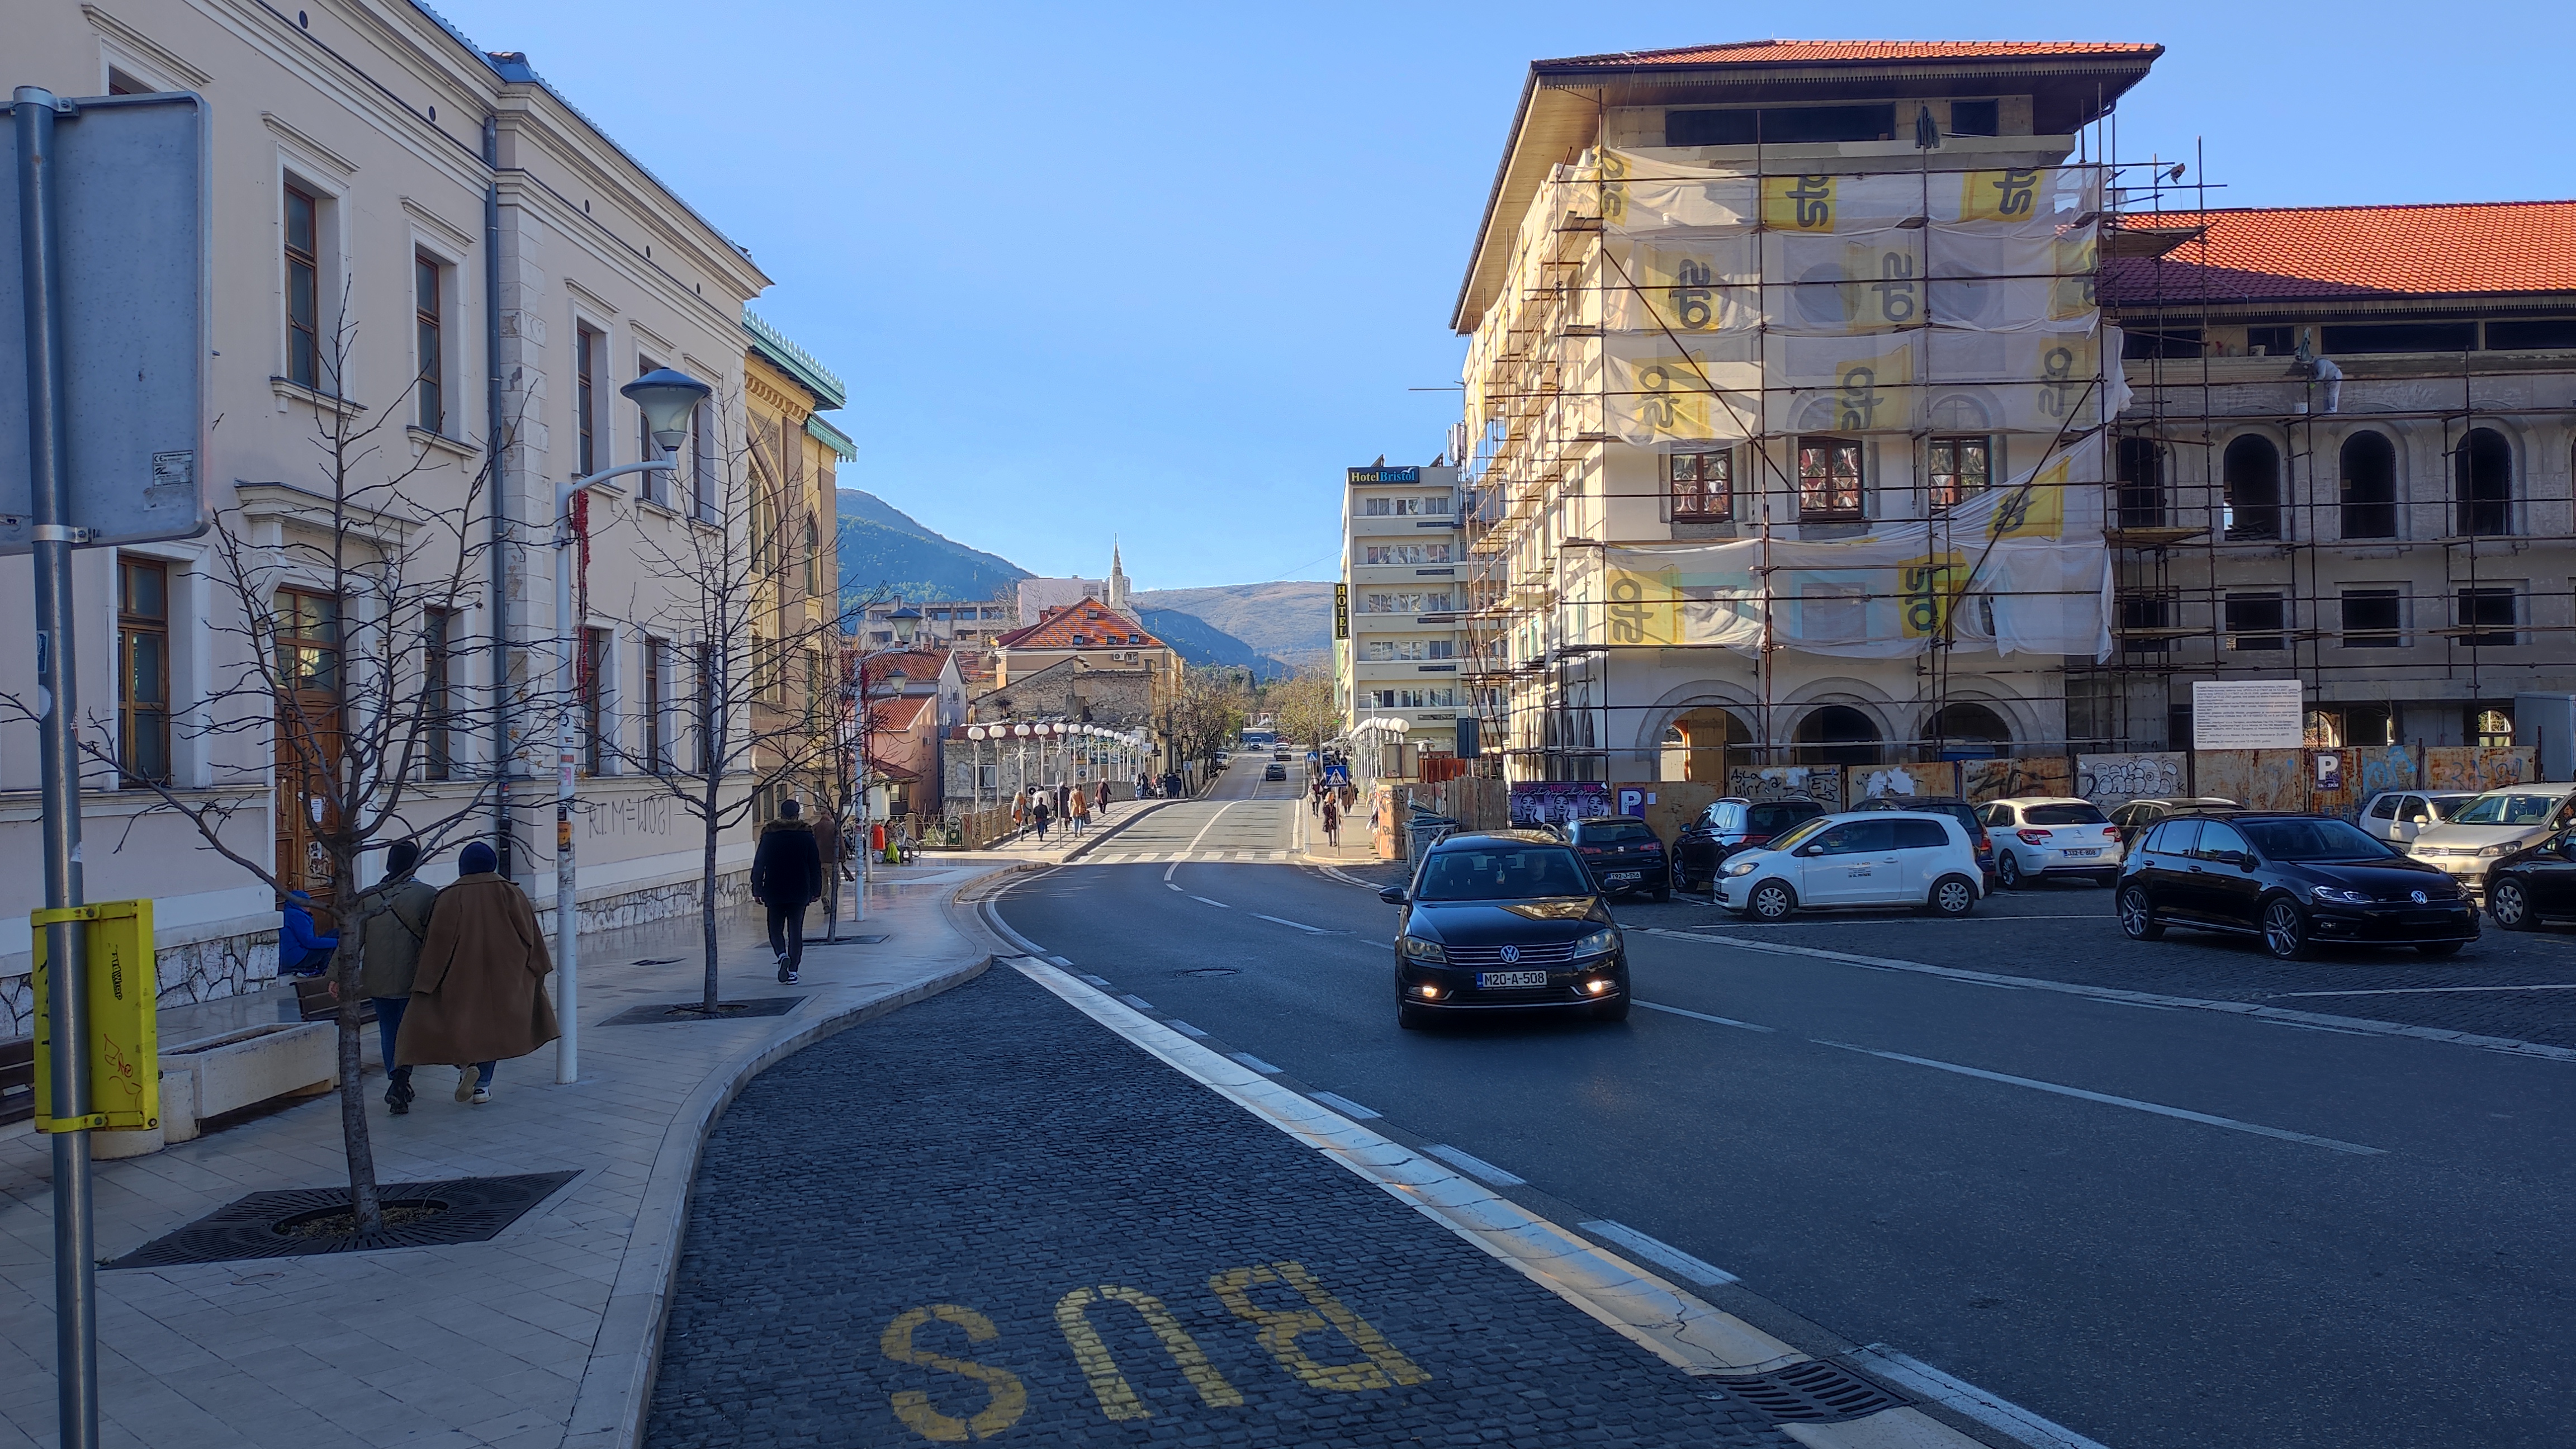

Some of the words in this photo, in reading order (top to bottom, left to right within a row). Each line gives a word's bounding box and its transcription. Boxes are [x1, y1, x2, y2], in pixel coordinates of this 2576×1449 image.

[1351, 471, 1379, 482] Hotel
[1380, 471, 1415, 481] Bristol
[1337, 585, 1347, 637] HOTEL
[2318, 756, 2338, 780] P
[1621, 790, 1642, 815] P
[1484, 972, 1545, 986] M20-A-508
[880, 1259, 1433, 1442] BUS
